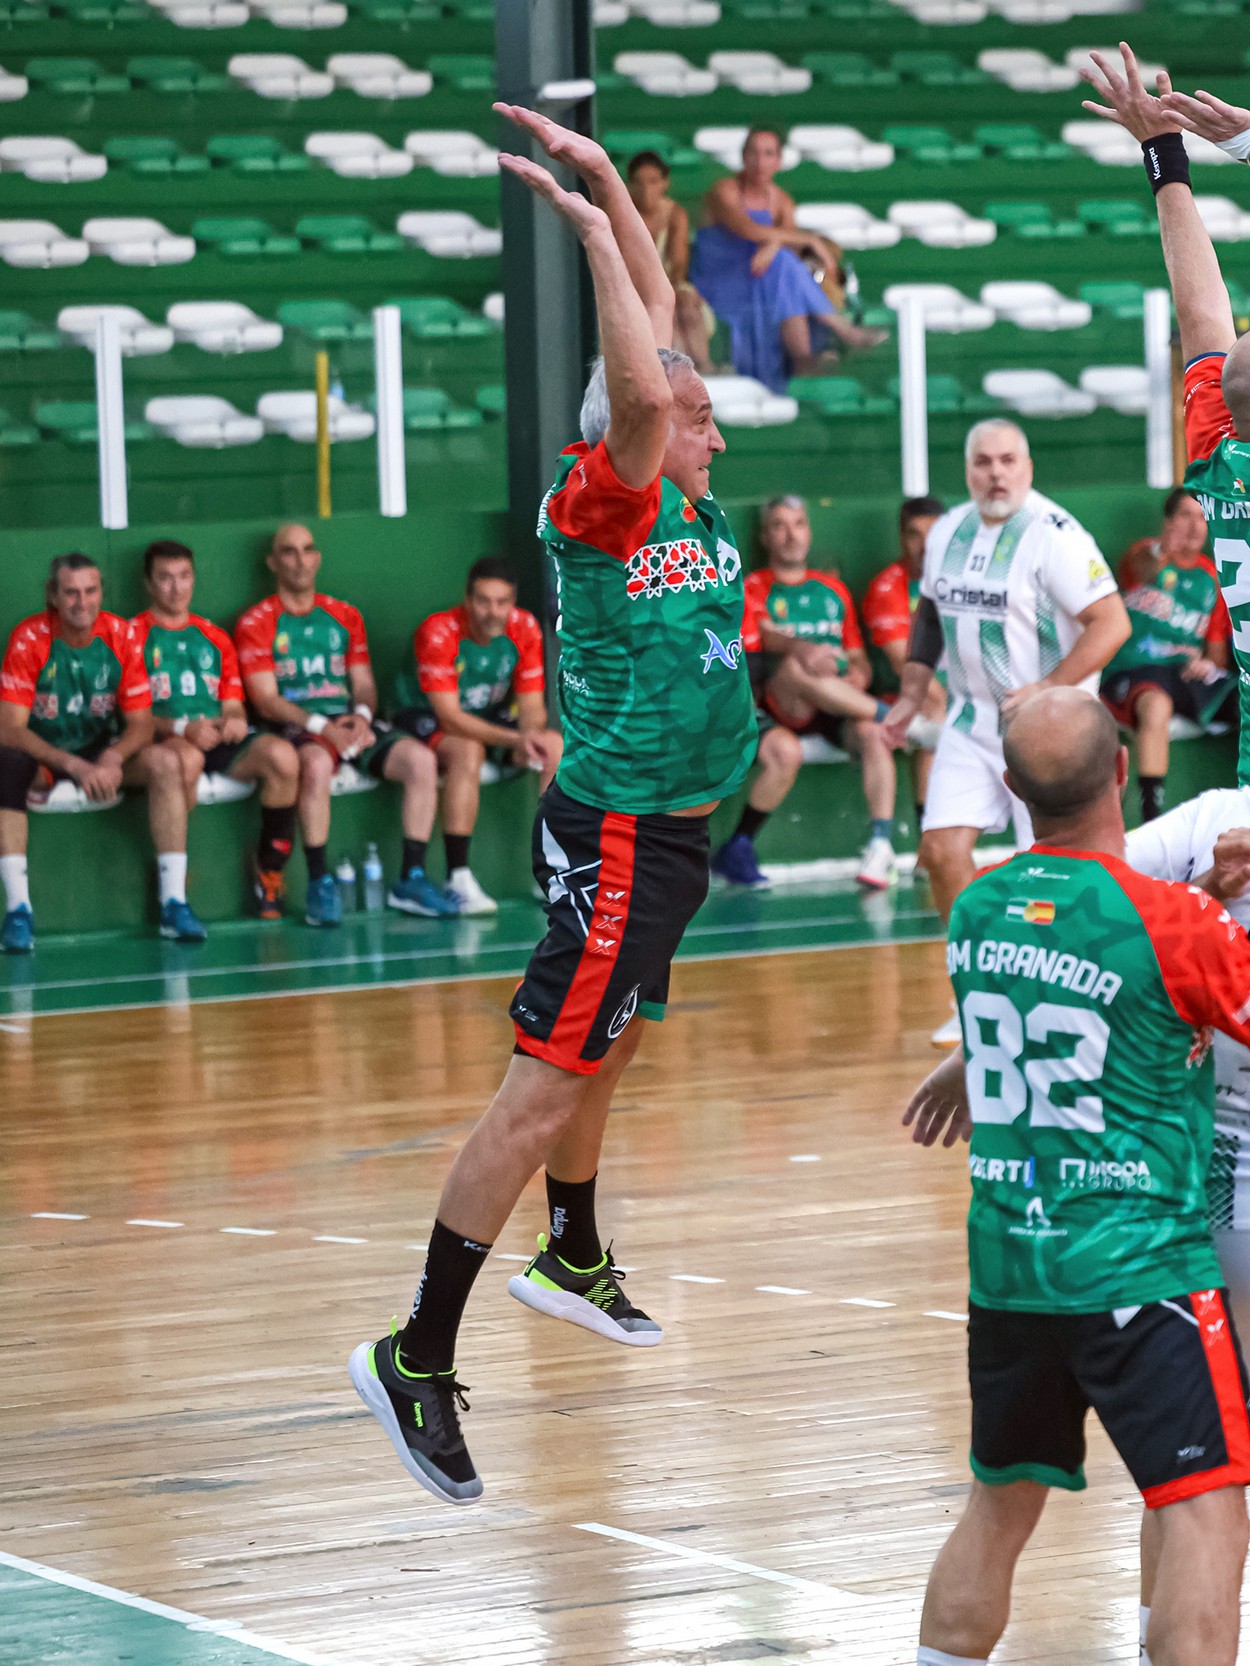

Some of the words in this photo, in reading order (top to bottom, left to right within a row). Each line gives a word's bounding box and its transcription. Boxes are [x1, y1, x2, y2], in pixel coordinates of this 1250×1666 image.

[1148, 147, 1162, 180] Kempa
[934, 578, 1008, 608] Cristal
[977, 940, 1123, 1006] GRANADA
[962, 989, 1111, 1133] 82
[551, 1206, 570, 1239] Kempa
